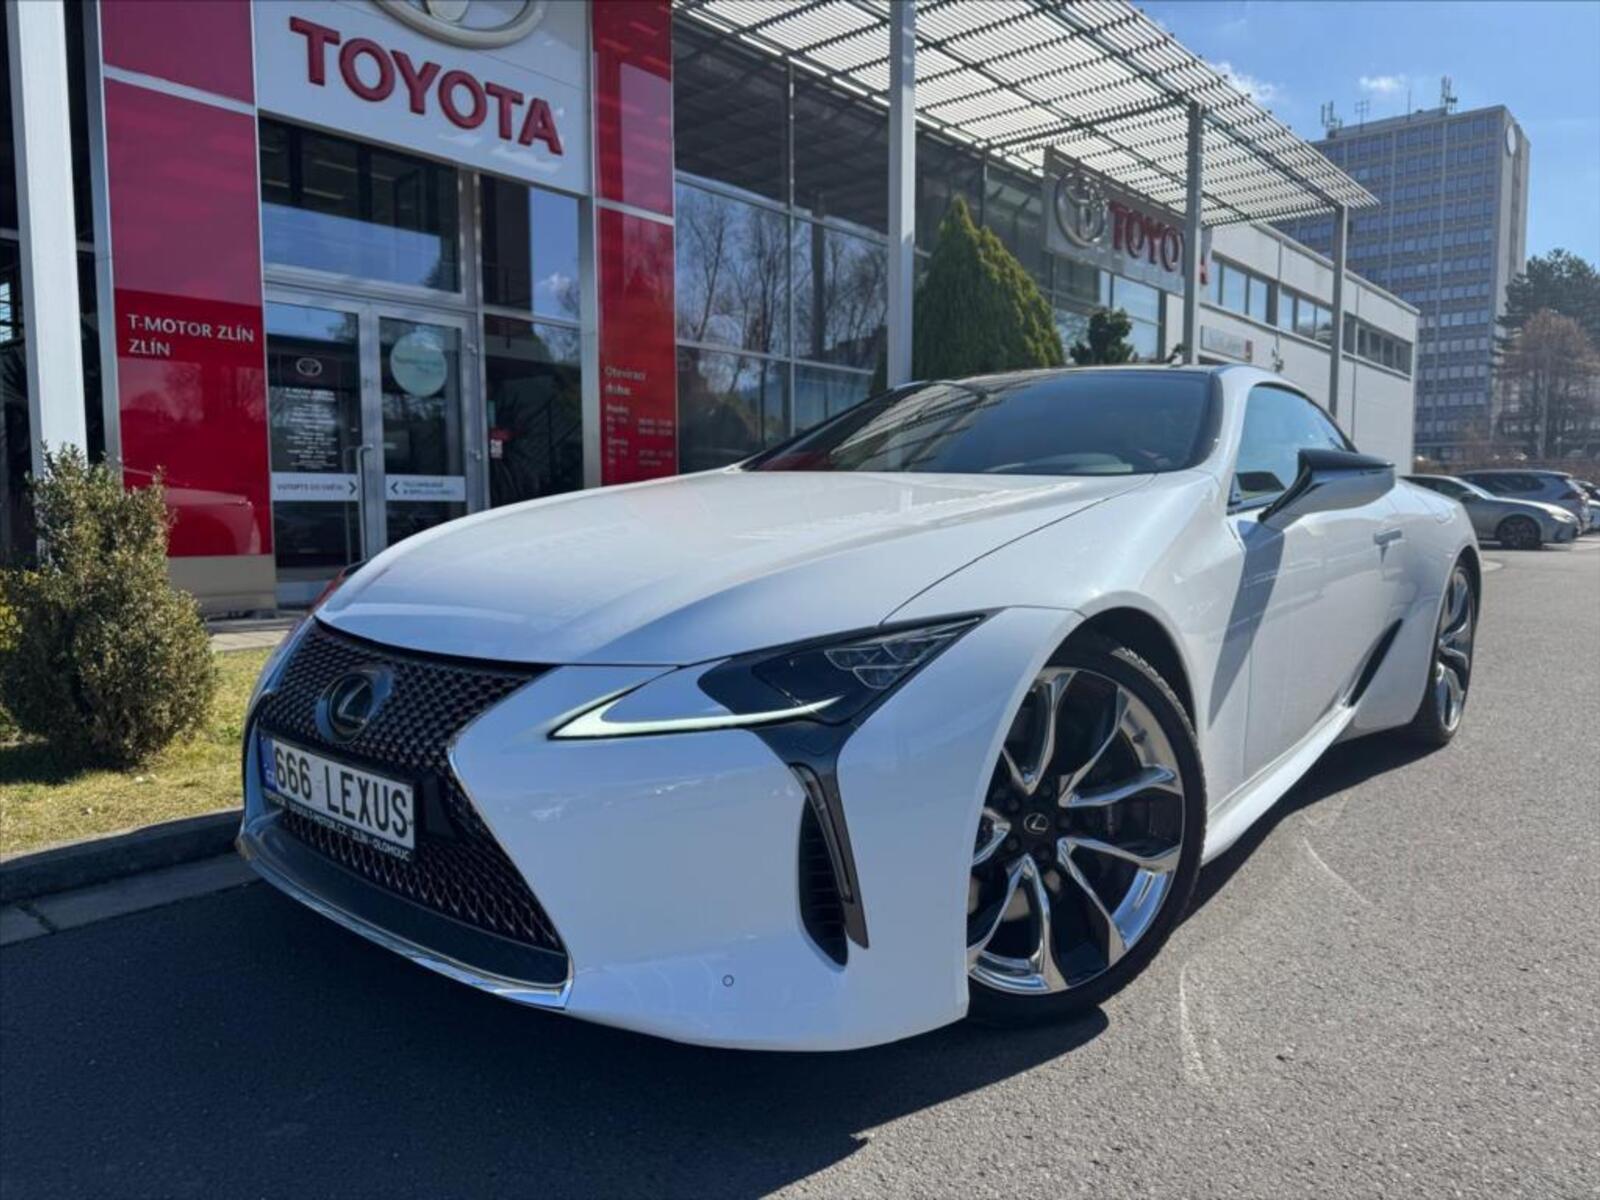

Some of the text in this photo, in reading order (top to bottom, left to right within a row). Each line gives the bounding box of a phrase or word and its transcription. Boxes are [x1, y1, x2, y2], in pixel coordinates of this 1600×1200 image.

[289, 16, 564, 156] TOYOTA
[1108, 200, 1208, 285] TOYO
[127, 313, 254, 342] T-MOTOR ZLÍN
[128, 337, 171, 357] ZLÍN
[275, 747, 408, 839] 666 LEXUS
